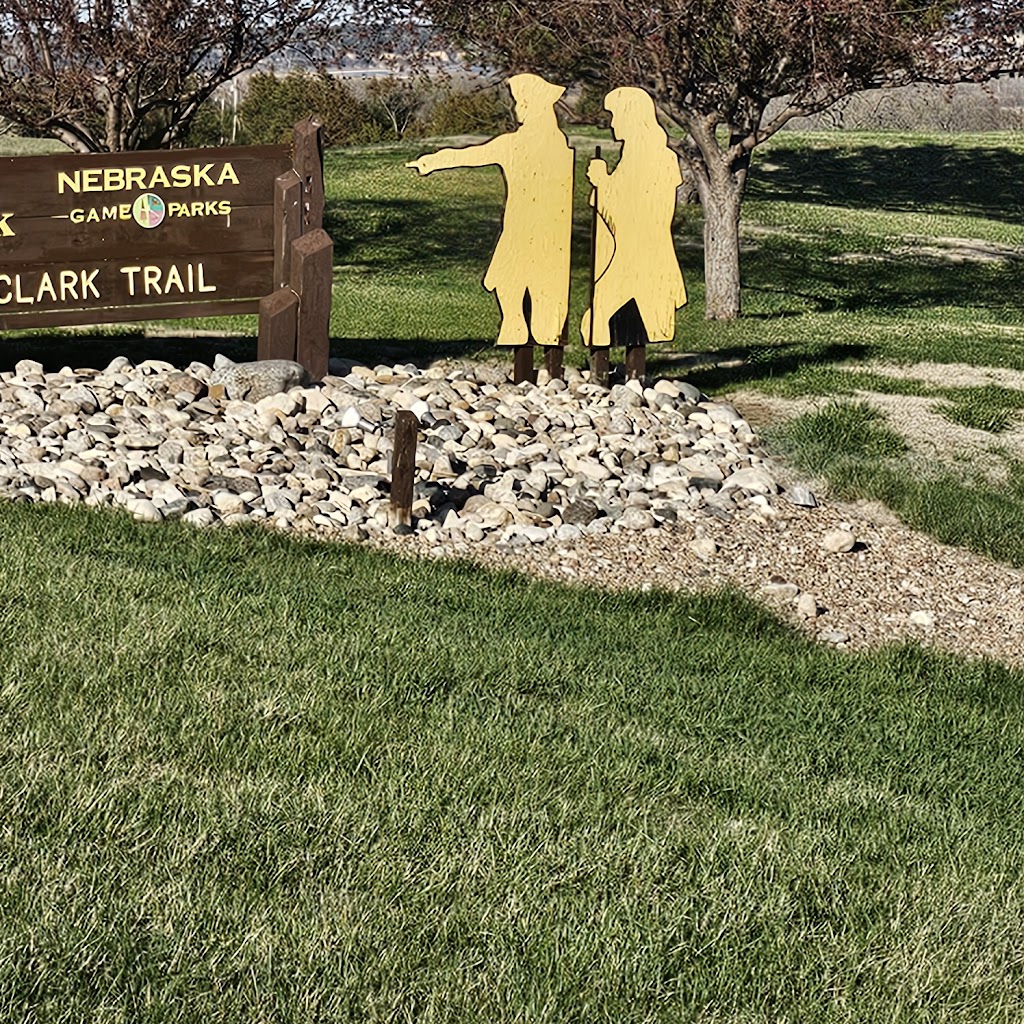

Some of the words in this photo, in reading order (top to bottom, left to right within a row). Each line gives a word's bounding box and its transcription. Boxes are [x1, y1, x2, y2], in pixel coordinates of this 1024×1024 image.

[57, 162, 240, 194] NEBRASKA
[70, 204, 132, 224] GAME
[168, 200, 232, 218] PARKS
[120, 263, 217, 297] TRAIL
